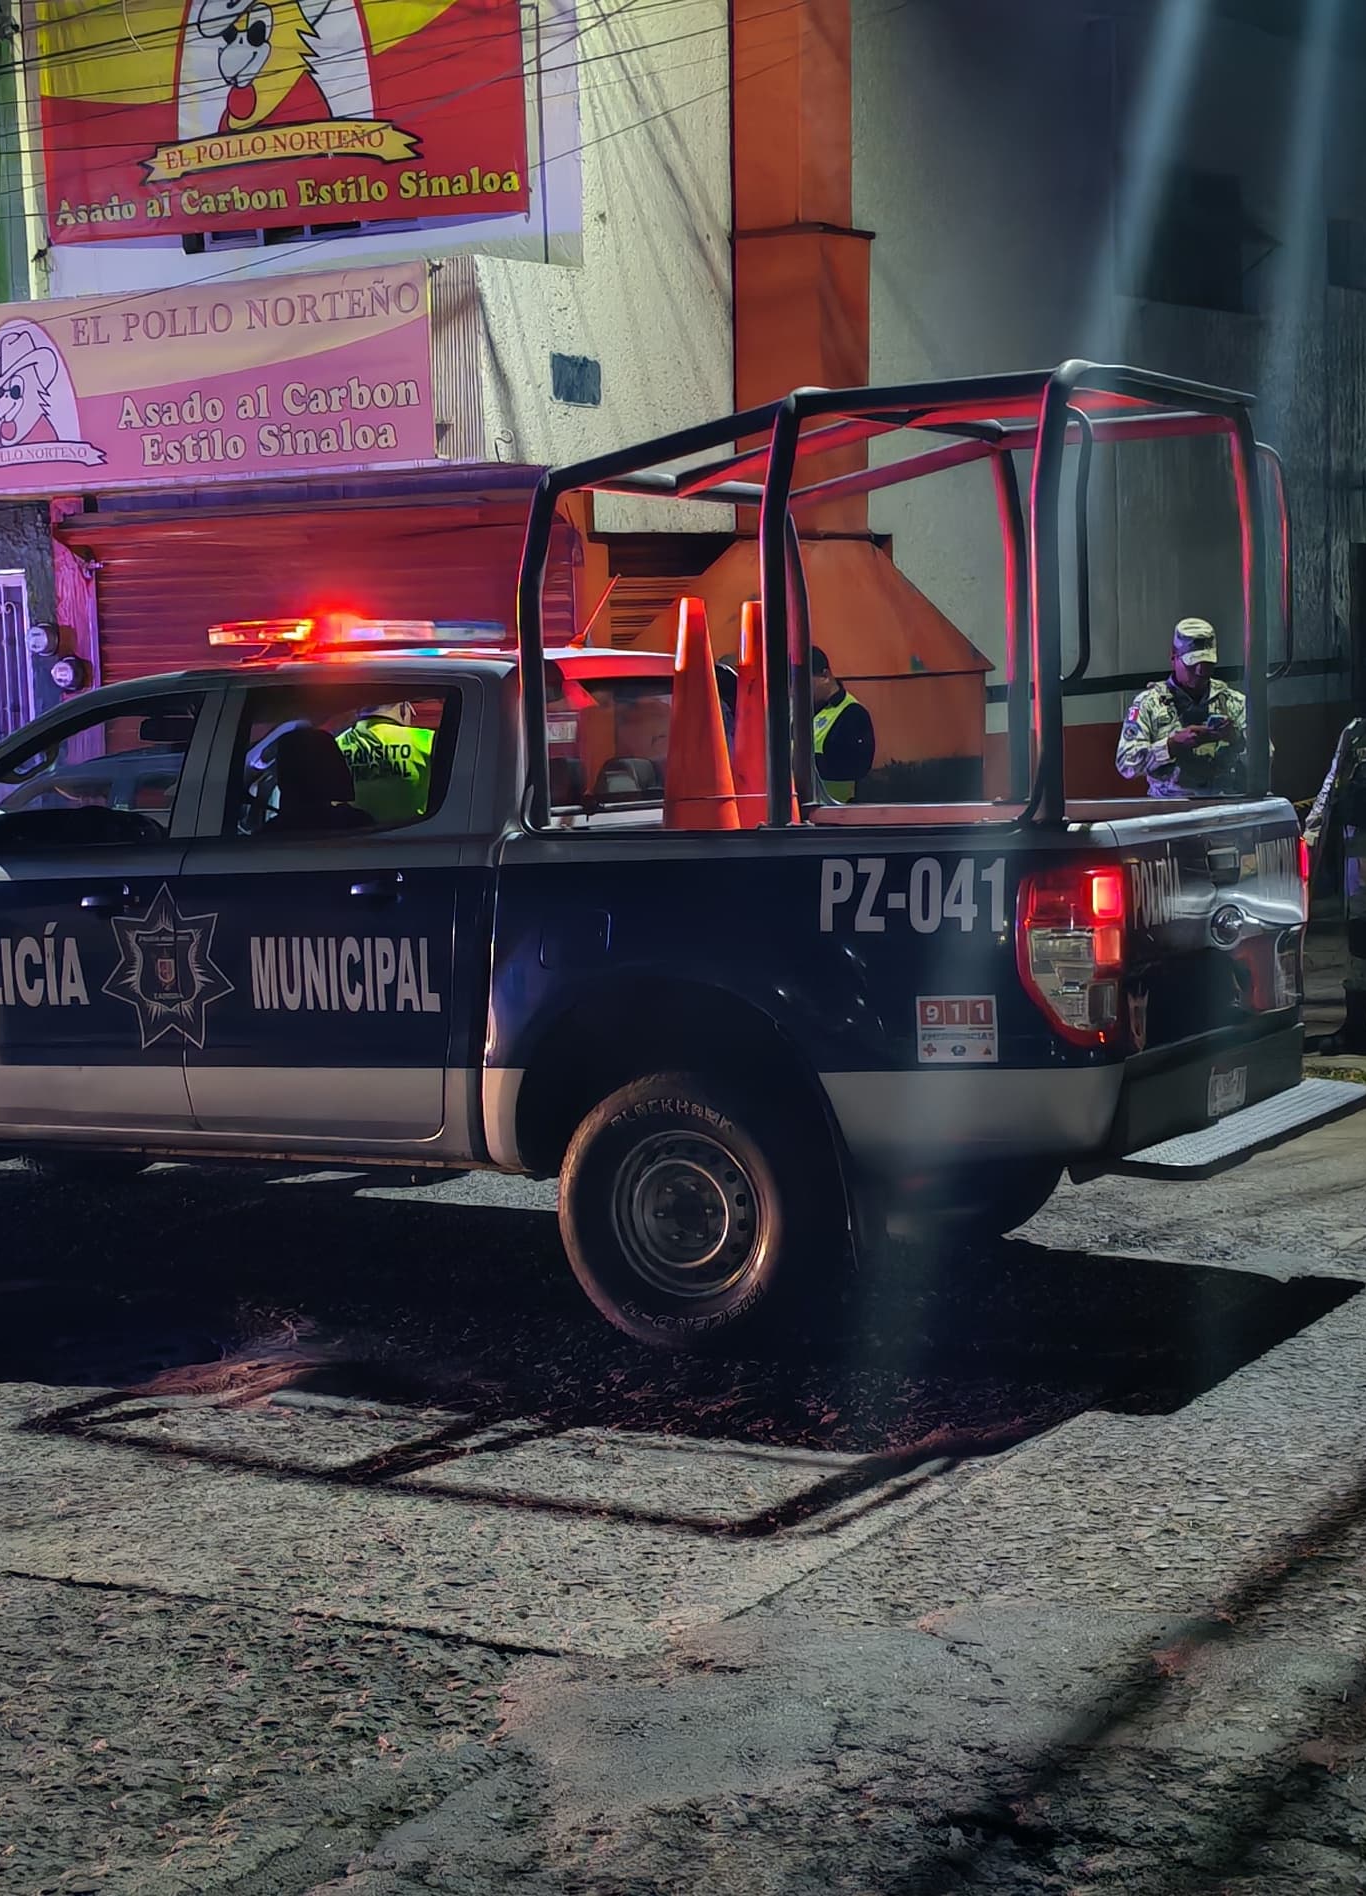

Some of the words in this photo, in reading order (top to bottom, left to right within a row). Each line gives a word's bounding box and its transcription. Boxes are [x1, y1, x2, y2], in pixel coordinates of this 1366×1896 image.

[165, 150, 191, 170] EL
[196, 135, 267, 164] POLLO
[273, 124, 384, 152] NORTEÑO
[55, 193, 137, 227] Asado
[145, 194, 172, 219] al
[180, 180, 289, 216] Carbon
[296, 175, 389, 207] Estilo
[399, 166, 521, 198] Sinaloa
[70, 316, 110, 346] EL
[122, 303, 234, 342] POLLO
[245, 280, 420, 331] NORTEÑO
[117, 394, 225, 430] Asado
[235, 384, 271, 419] al
[281, 376, 420, 415] Carbon
[140, 432, 247, 467] Estilo
[257, 420, 398, 458] Sinaloa
[819, 855, 1007, 935] PZ-041
[249, 935, 442, 1013] MUNICIPAL
[925, 1002, 987, 1023] 911
